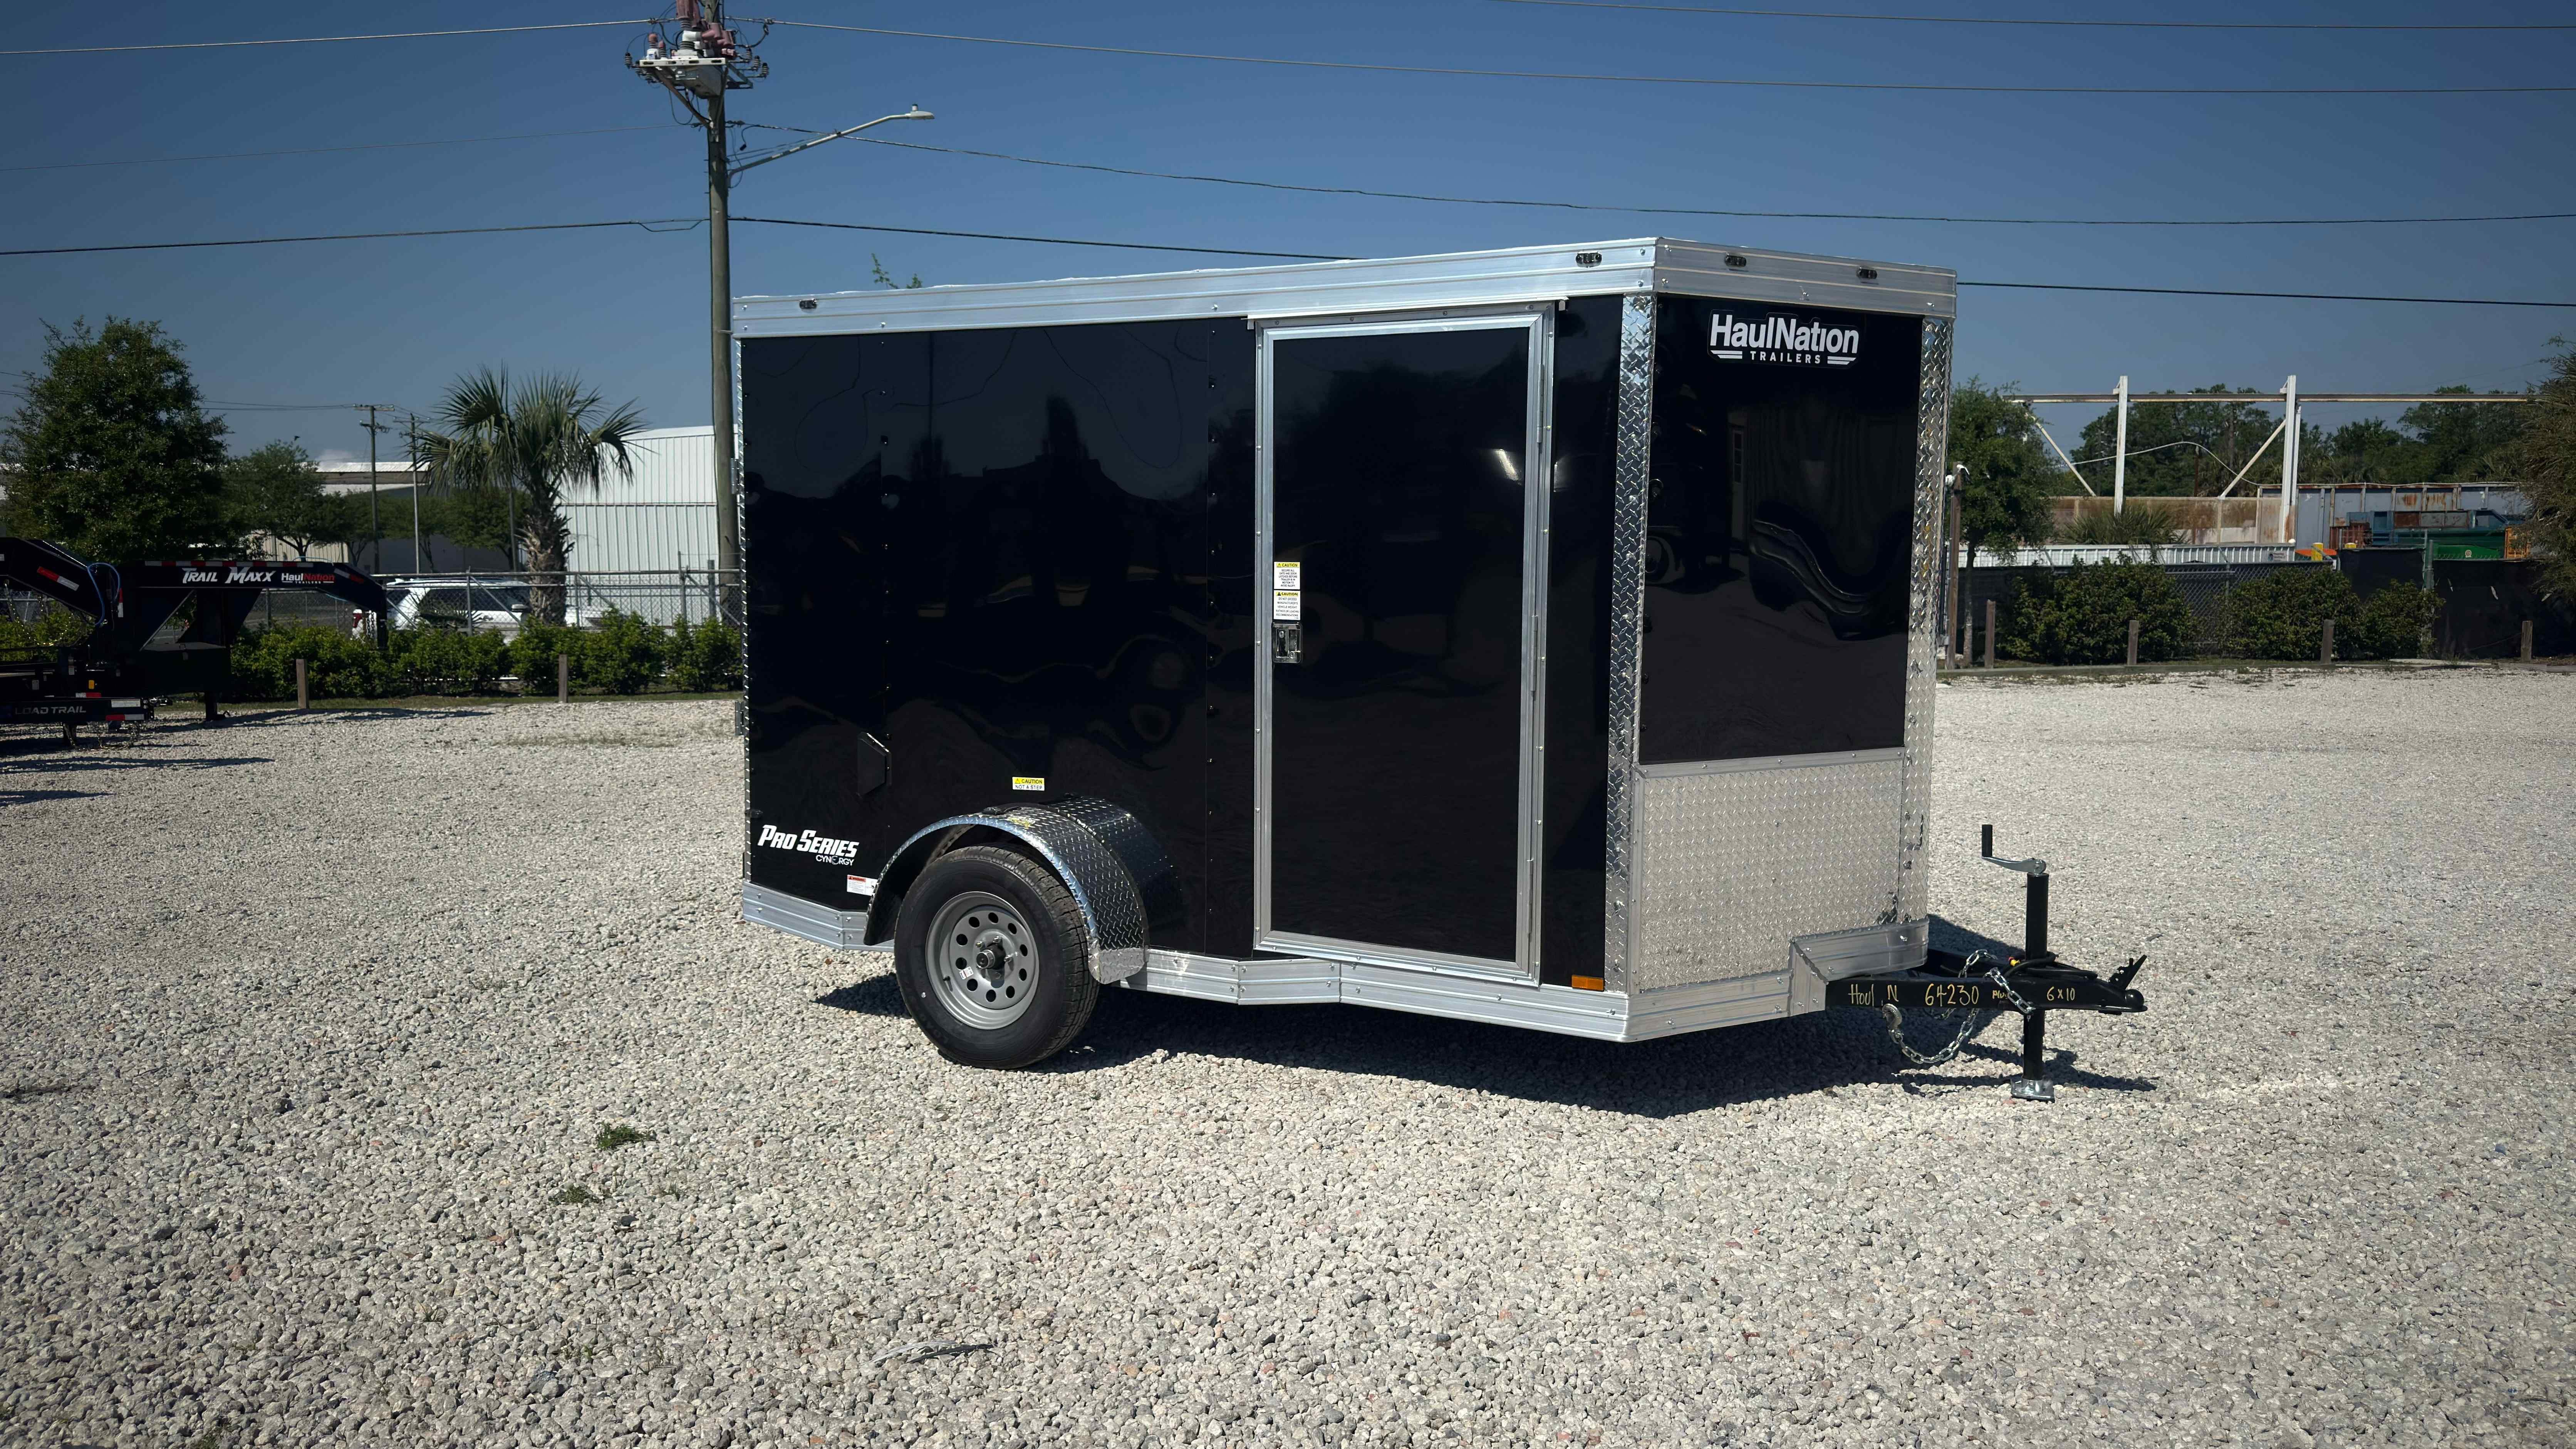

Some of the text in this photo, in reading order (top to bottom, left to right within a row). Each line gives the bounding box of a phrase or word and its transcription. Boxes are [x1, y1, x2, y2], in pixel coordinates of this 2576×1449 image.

[1710, 314, 1859, 354] HaulNation
[1750, 351, 1820, 364] TRAILERS
[15, 707, 49, 715] LOAD
[1887, 984, 1899, 1002] N
[1925, 983, 1979, 1007] 64230
